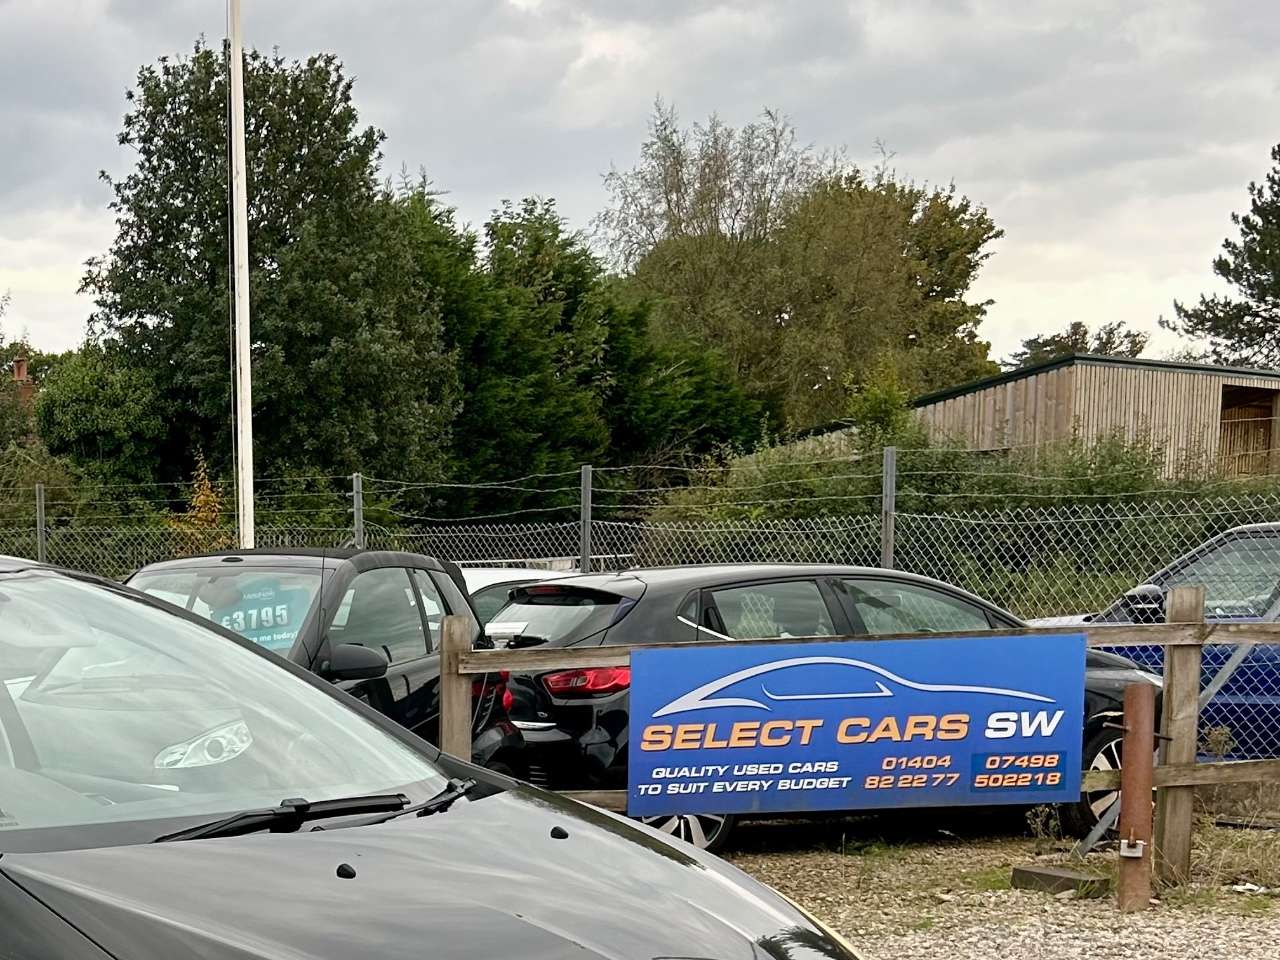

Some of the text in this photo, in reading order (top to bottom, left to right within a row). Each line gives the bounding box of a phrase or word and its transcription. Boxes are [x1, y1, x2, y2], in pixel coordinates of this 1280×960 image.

[639, 710, 1065, 752] SELECT CARS SW
[881, 755, 952, 770] 01404
[985, 754, 1060, 769] 07498
[651, 761, 839, 779] QUALITY USED CARS
[638, 777, 853, 795] TO SUIT EVERY BUDGET
[974, 772, 1061, 787] 502218
